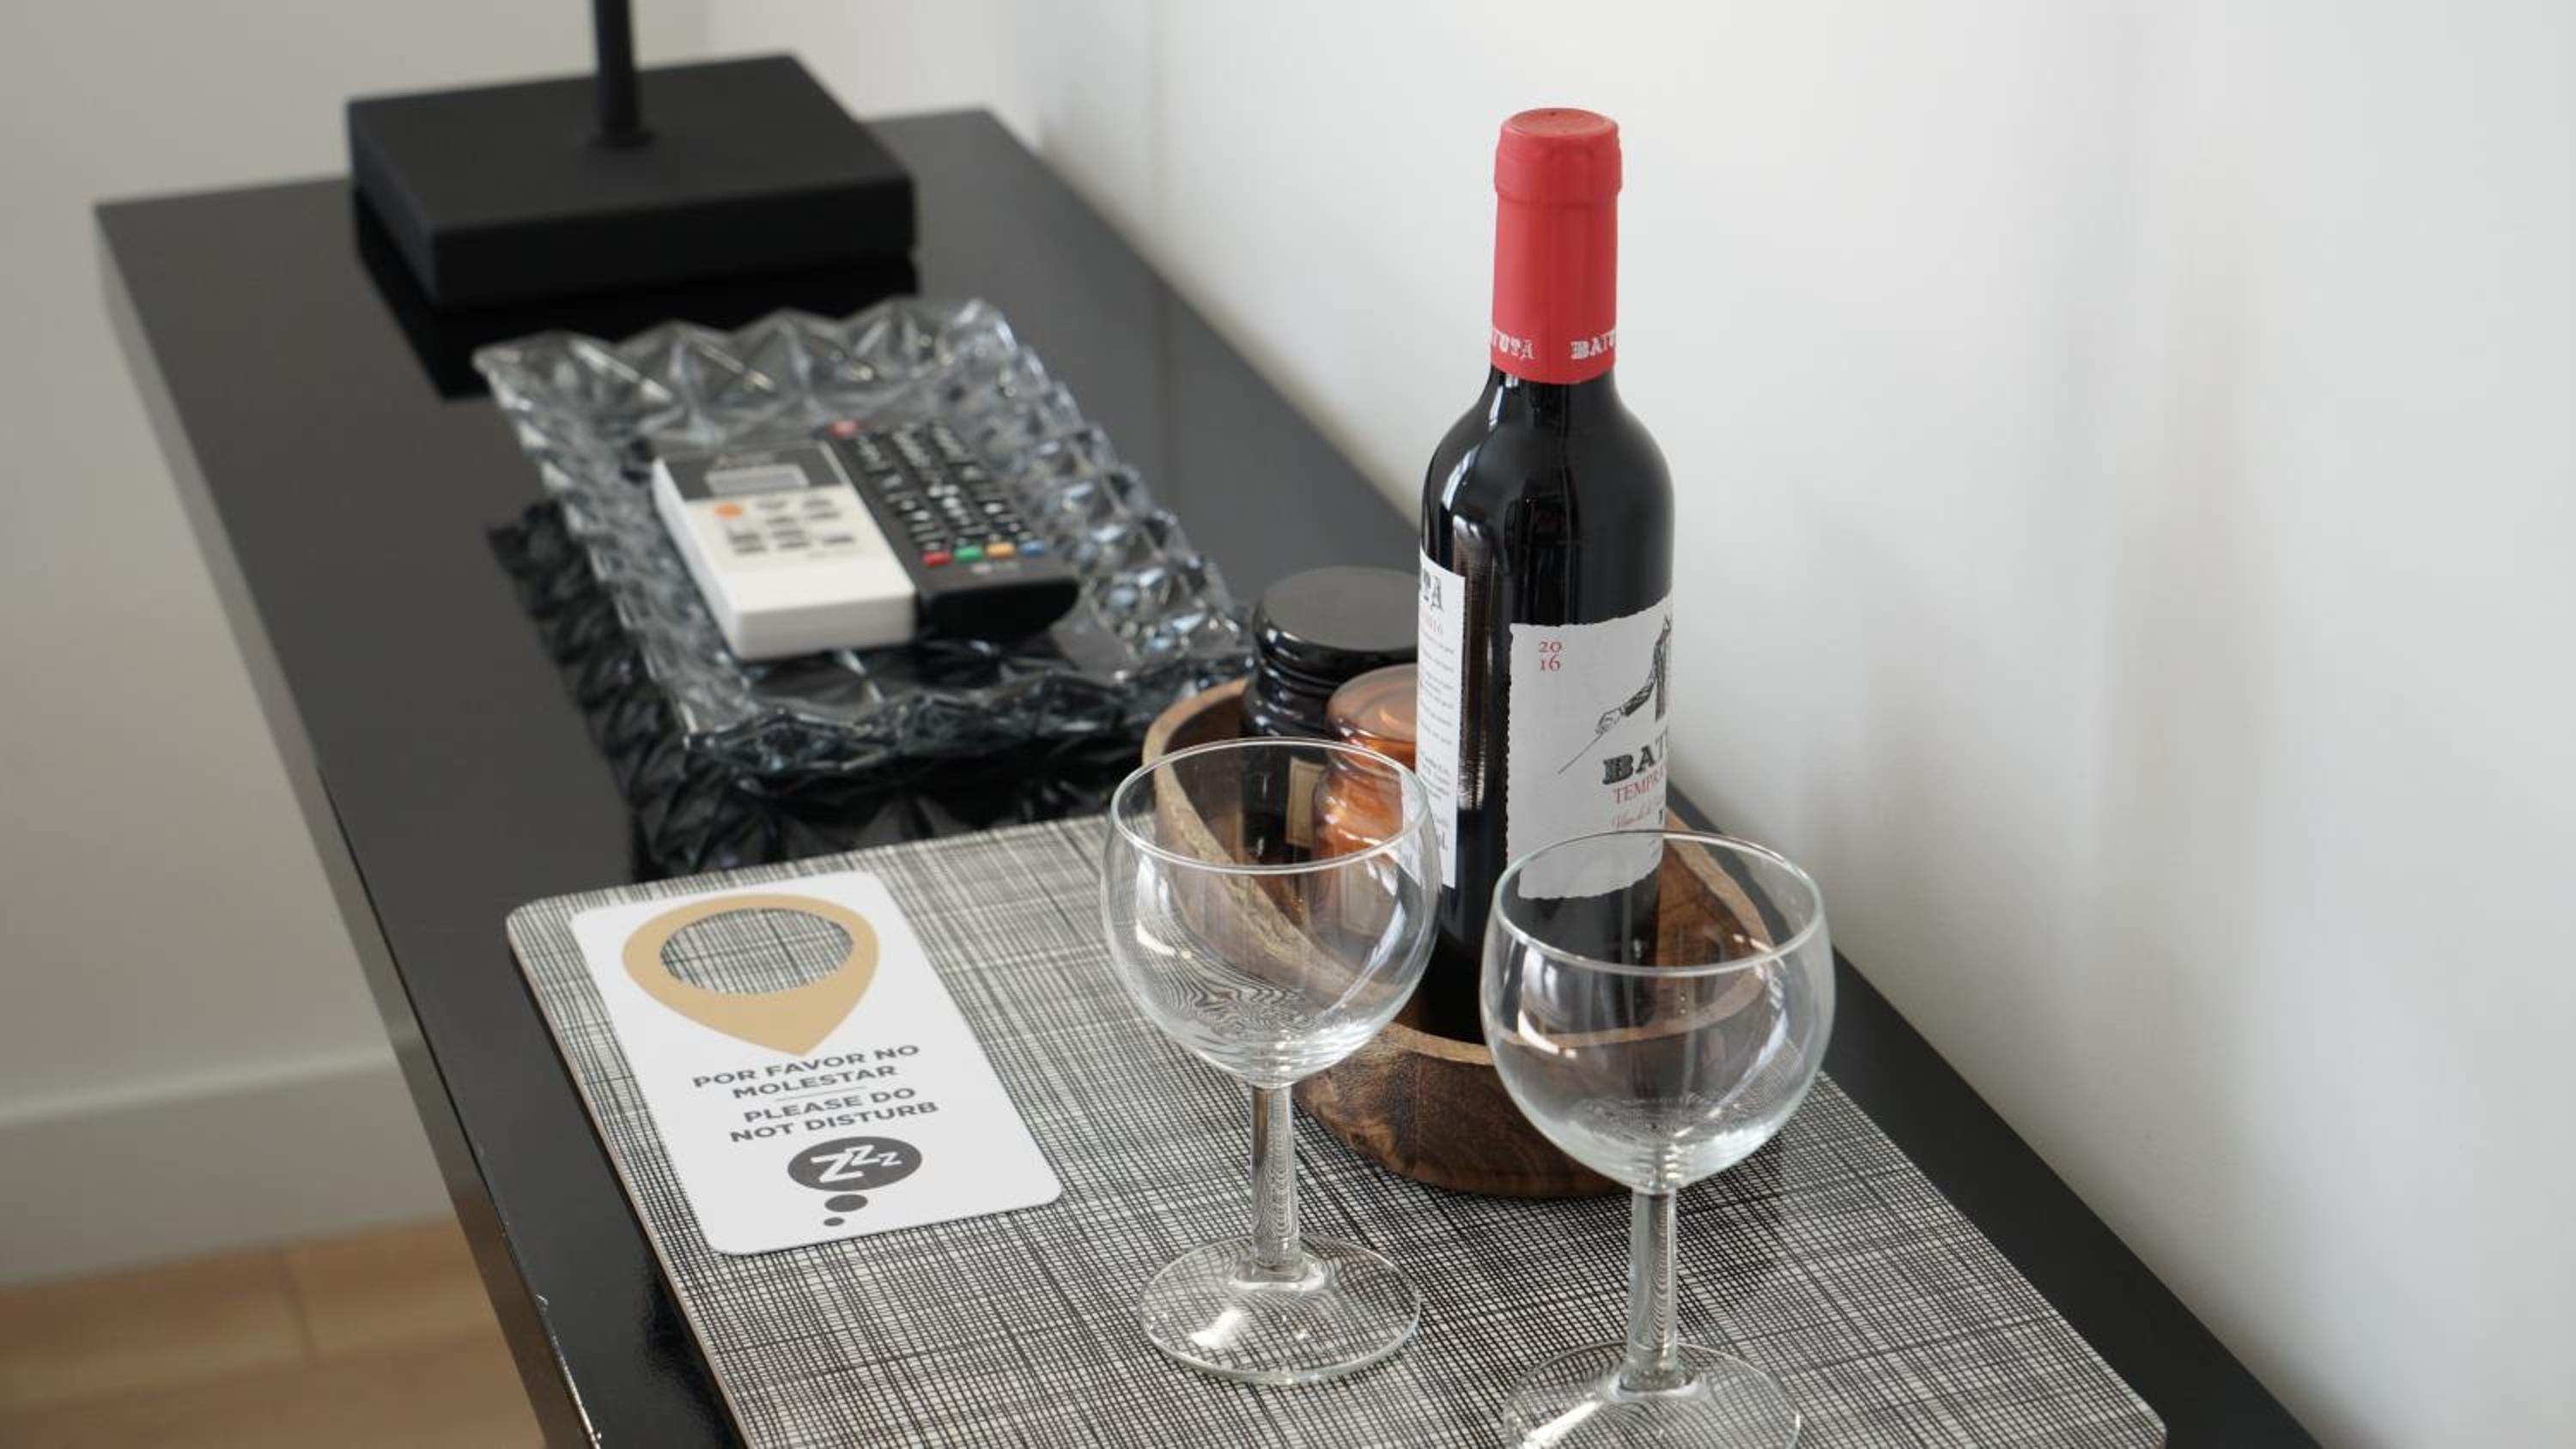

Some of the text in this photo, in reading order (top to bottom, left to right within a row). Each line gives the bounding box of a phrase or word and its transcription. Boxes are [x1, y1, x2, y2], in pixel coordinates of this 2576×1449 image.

[1538, 640, 1563, 653] 20
[1539, 653, 1561, 671] 16
[1602, 726, 1668, 785] BAT
[693, 1045, 920, 1088] POR FAVOR NO
[732, 1065, 898, 1099] MOLESTAR
[730, 1101, 939, 1143] NOT DISTURB
[744, 1088, 916, 1123] PLEASE DO
